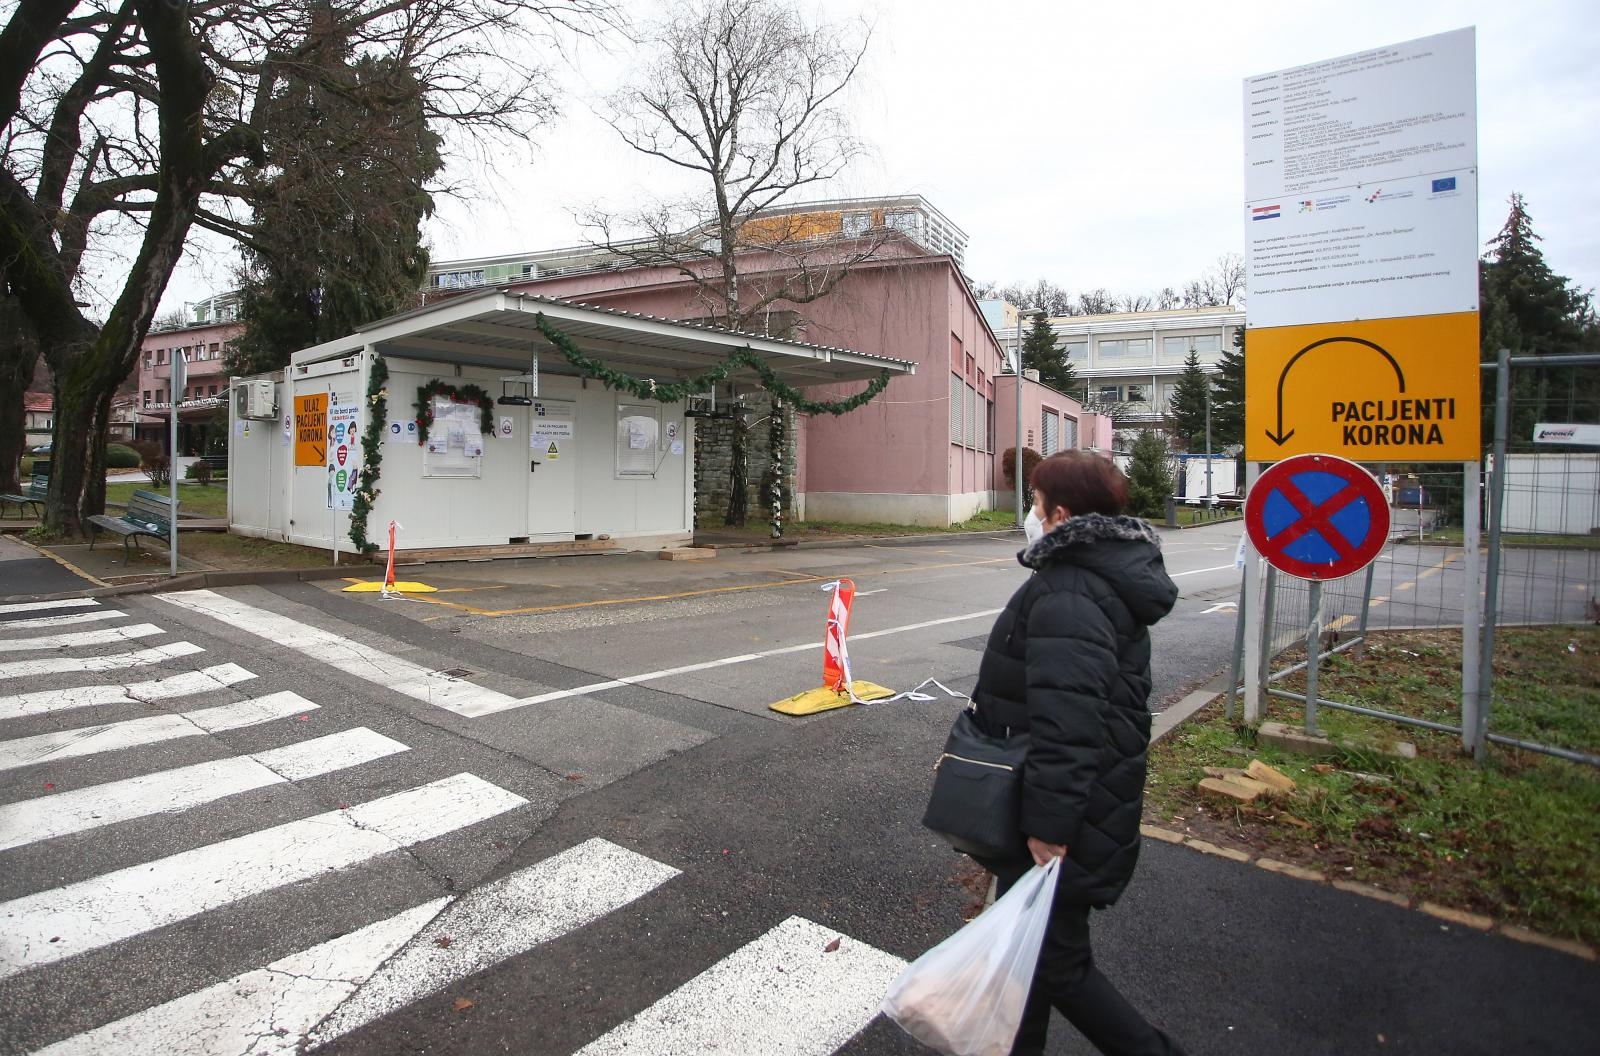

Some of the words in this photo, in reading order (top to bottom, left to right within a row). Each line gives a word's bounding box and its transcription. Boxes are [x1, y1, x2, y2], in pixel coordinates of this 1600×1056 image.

[304, 398, 320, 412] ULAZ
[1331, 398, 1455, 422] PACIJENTI
[296, 413, 326, 428] PACIJENTI
[300, 430, 323, 443] KORONA
[1343, 423, 1444, 446] KORONA
